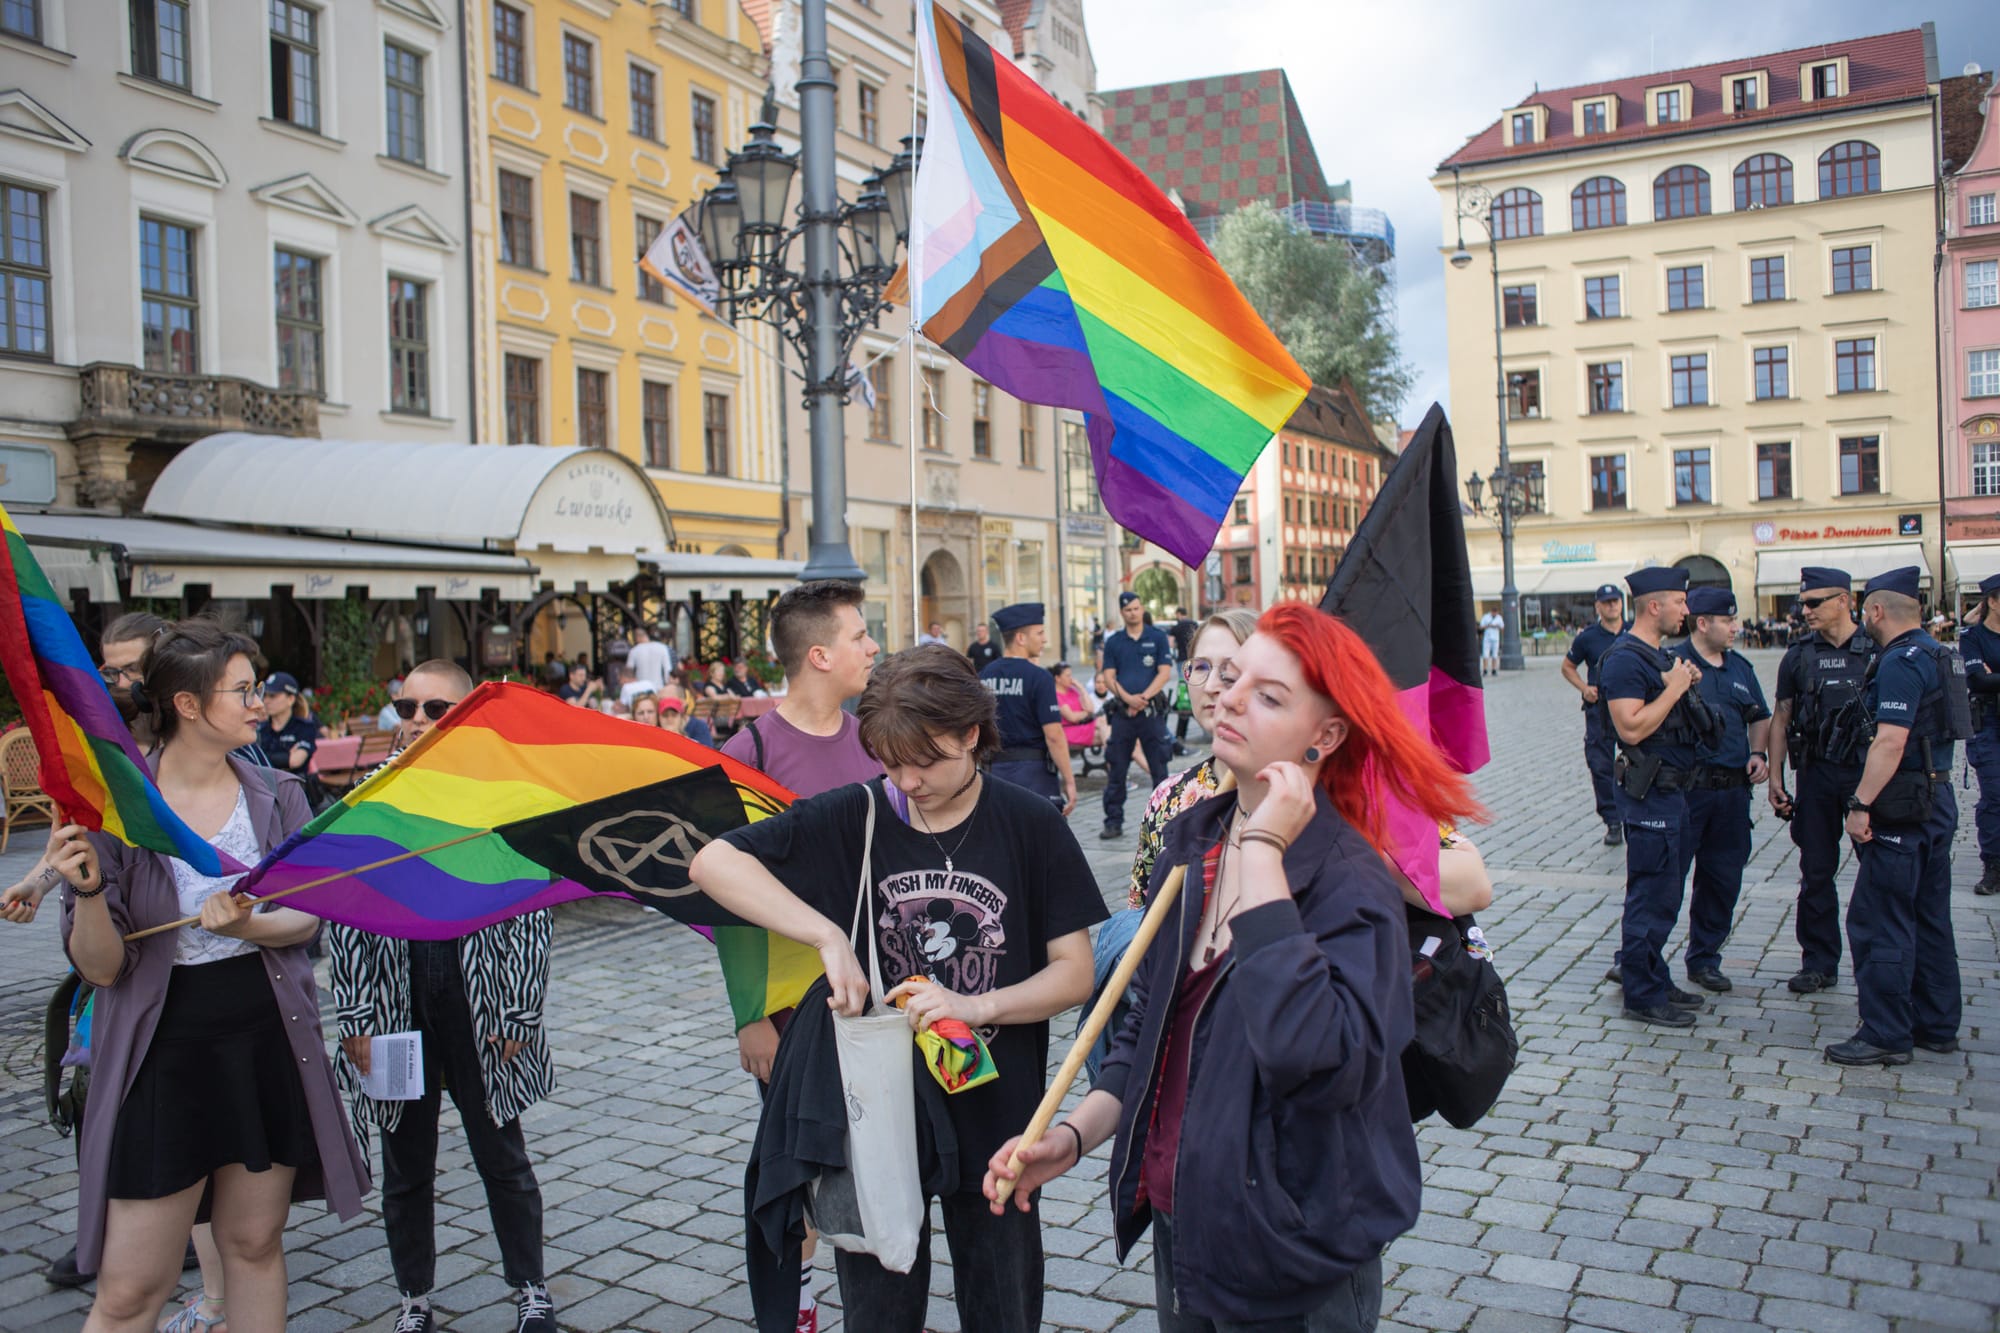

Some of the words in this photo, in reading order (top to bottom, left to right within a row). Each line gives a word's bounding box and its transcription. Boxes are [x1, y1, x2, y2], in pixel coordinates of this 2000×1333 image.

[1779, 527, 1818, 541] Pizza
[1823, 525, 1893, 539] Dominium
[1820, 658, 1846, 669] POLICJA
[1880, 701, 1908, 711] POLICJA
[887, 875, 921, 896] PUSH
[925, 873, 948, 889] MY
[949, 875, 1003, 914] FINGERS
